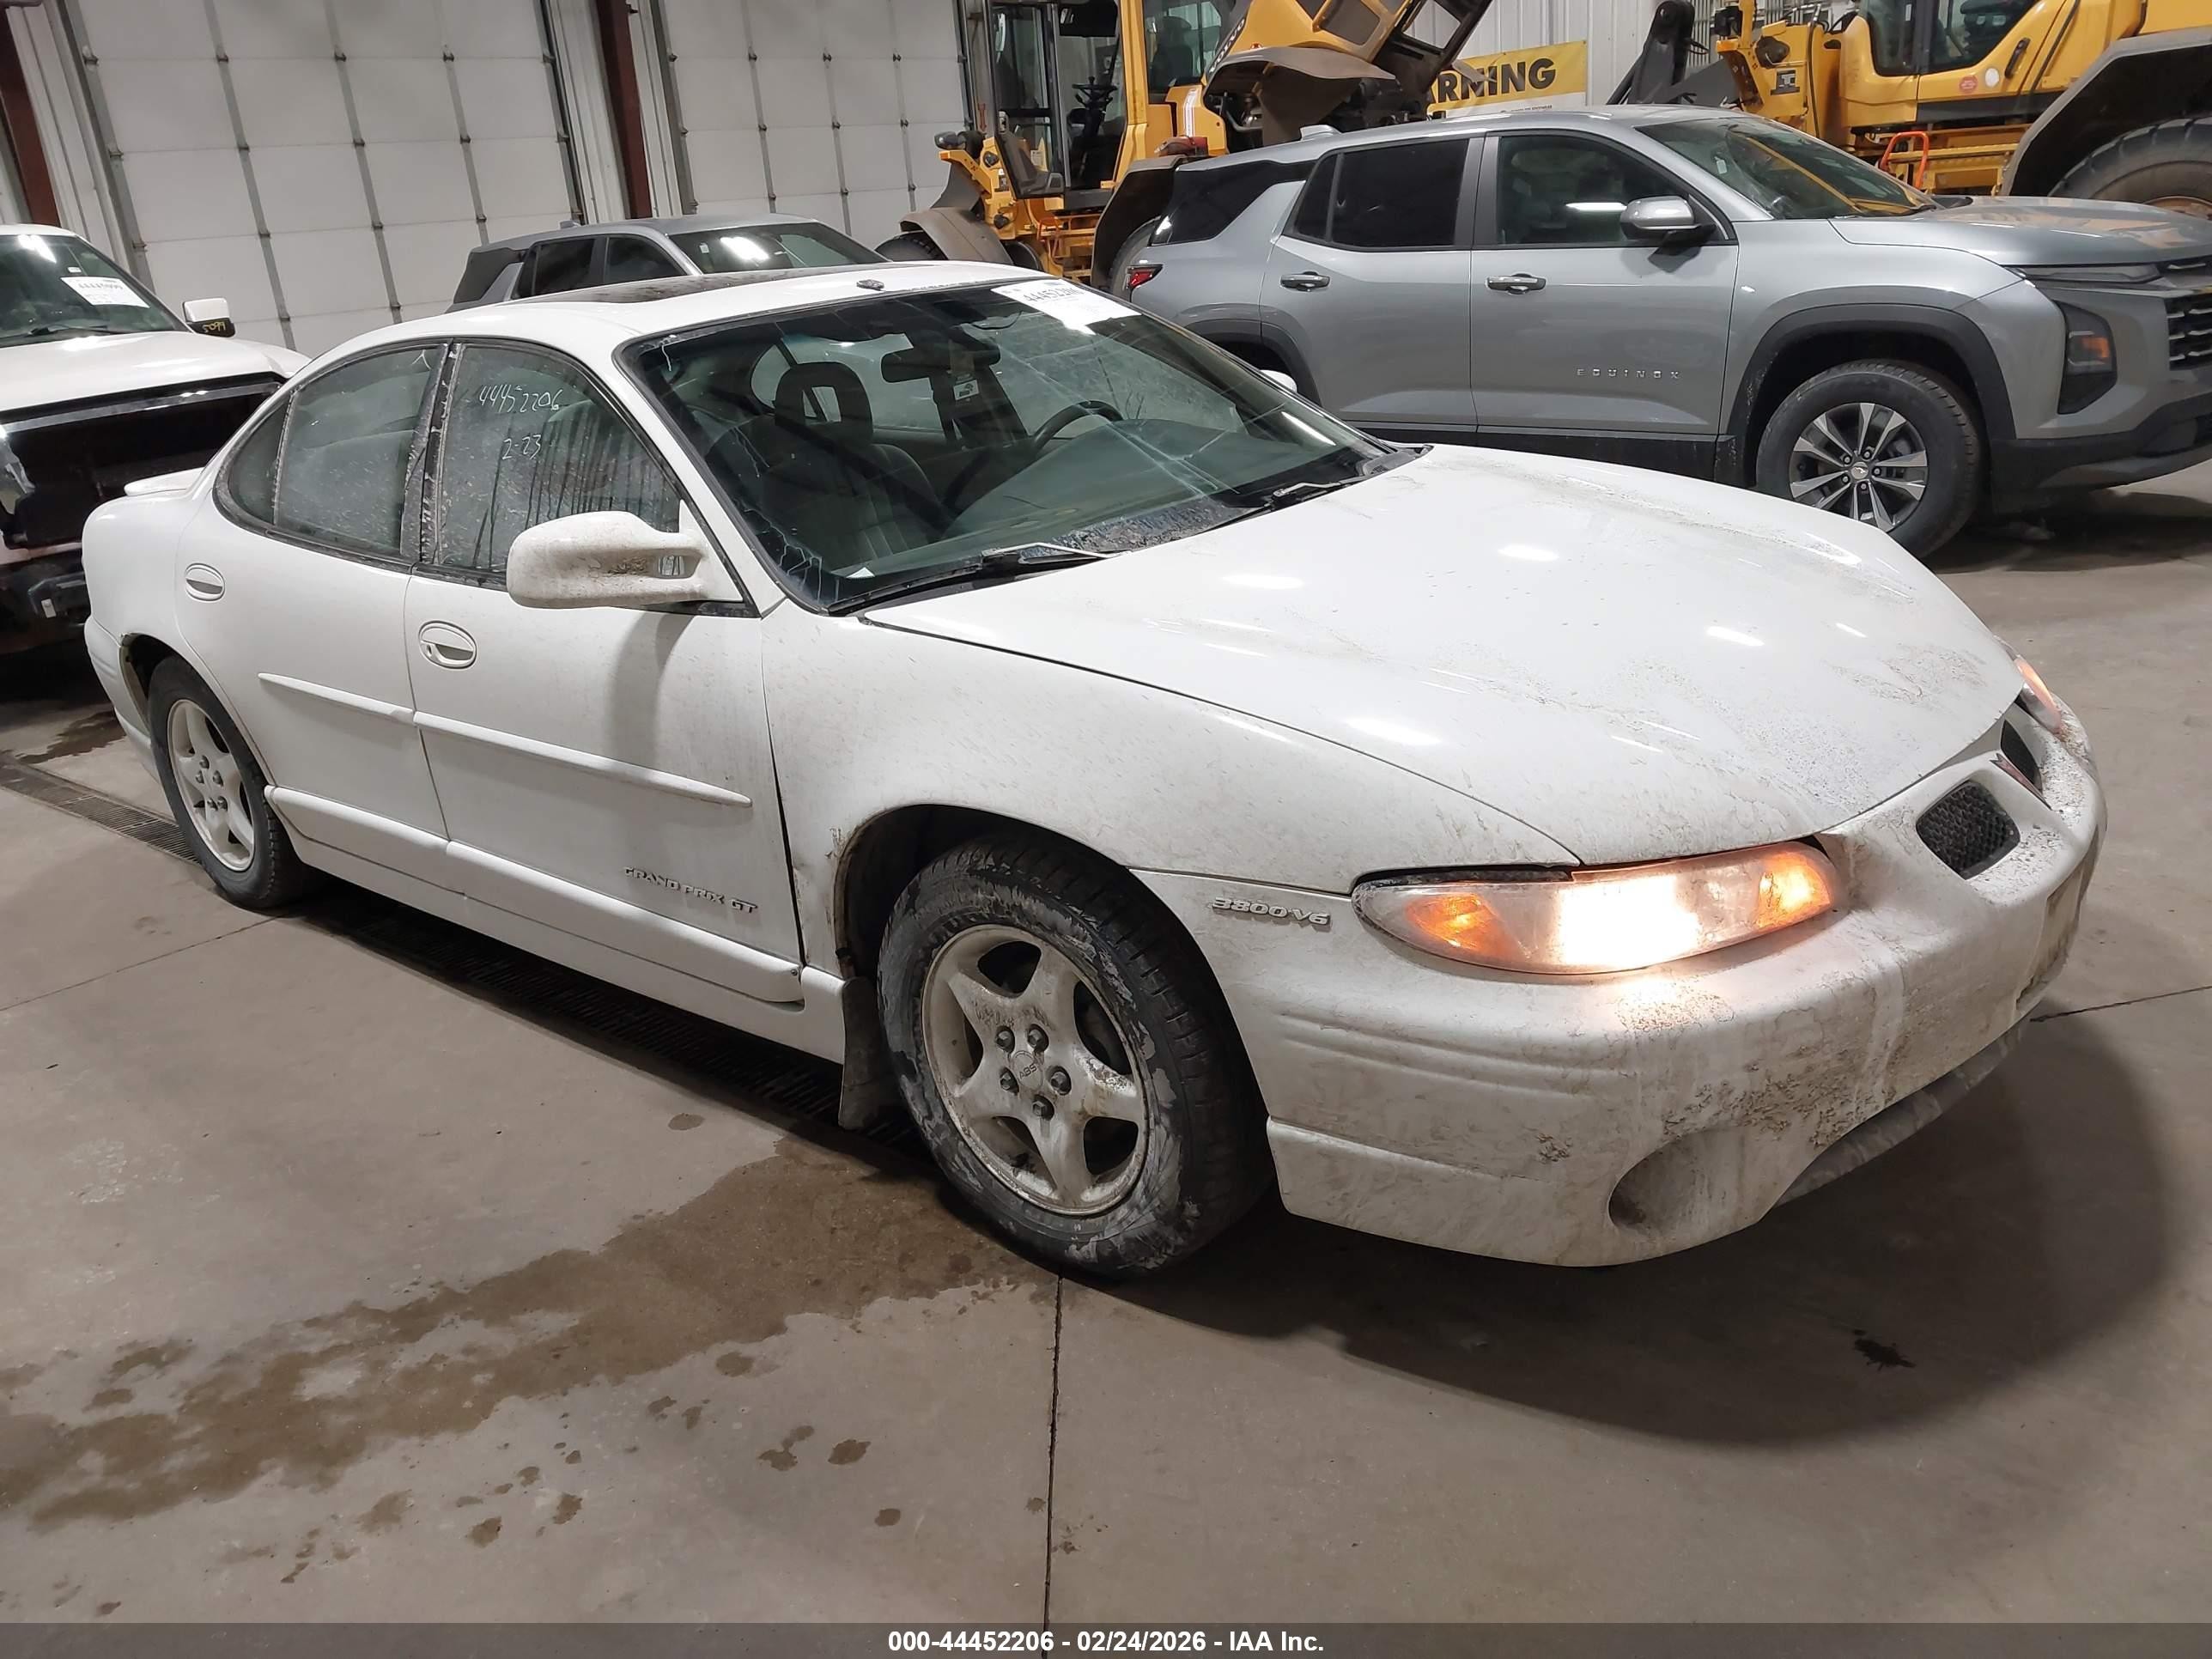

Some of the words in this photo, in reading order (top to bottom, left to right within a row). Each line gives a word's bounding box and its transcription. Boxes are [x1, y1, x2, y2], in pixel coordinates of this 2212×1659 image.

[1208, 18, 1246, 74] VOLVO
[1577, 368, 1680, 379] EQUINOX
[479, 384, 563, 413] 44452206
[501, 434, 542, 460] 2-23
[624, 866, 681, 891] GRAND
[681, 884, 726, 904] PRIX
[730, 897, 758, 914] GT
[1018, 1063, 1037, 1080] ABS
